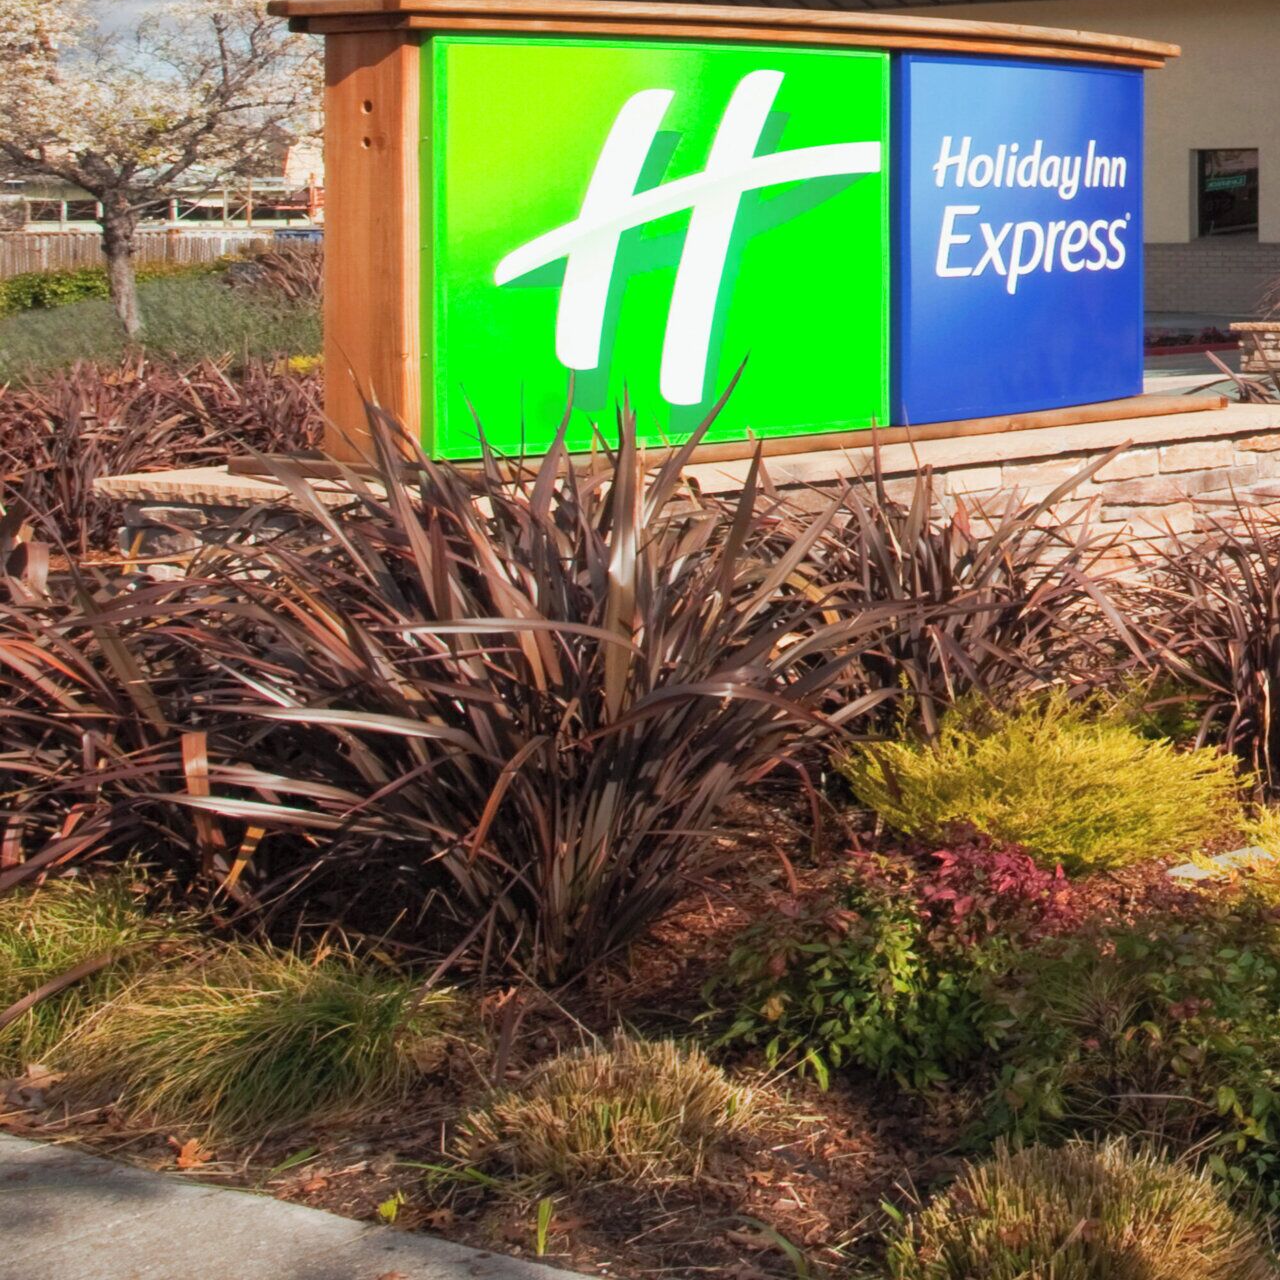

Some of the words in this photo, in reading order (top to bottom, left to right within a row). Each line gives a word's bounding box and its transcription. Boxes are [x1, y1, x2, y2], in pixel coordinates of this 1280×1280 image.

[933, 136, 1081, 200] Holiday
[1085, 140, 1127, 188] Inn
[935, 205, 1128, 295] Express
